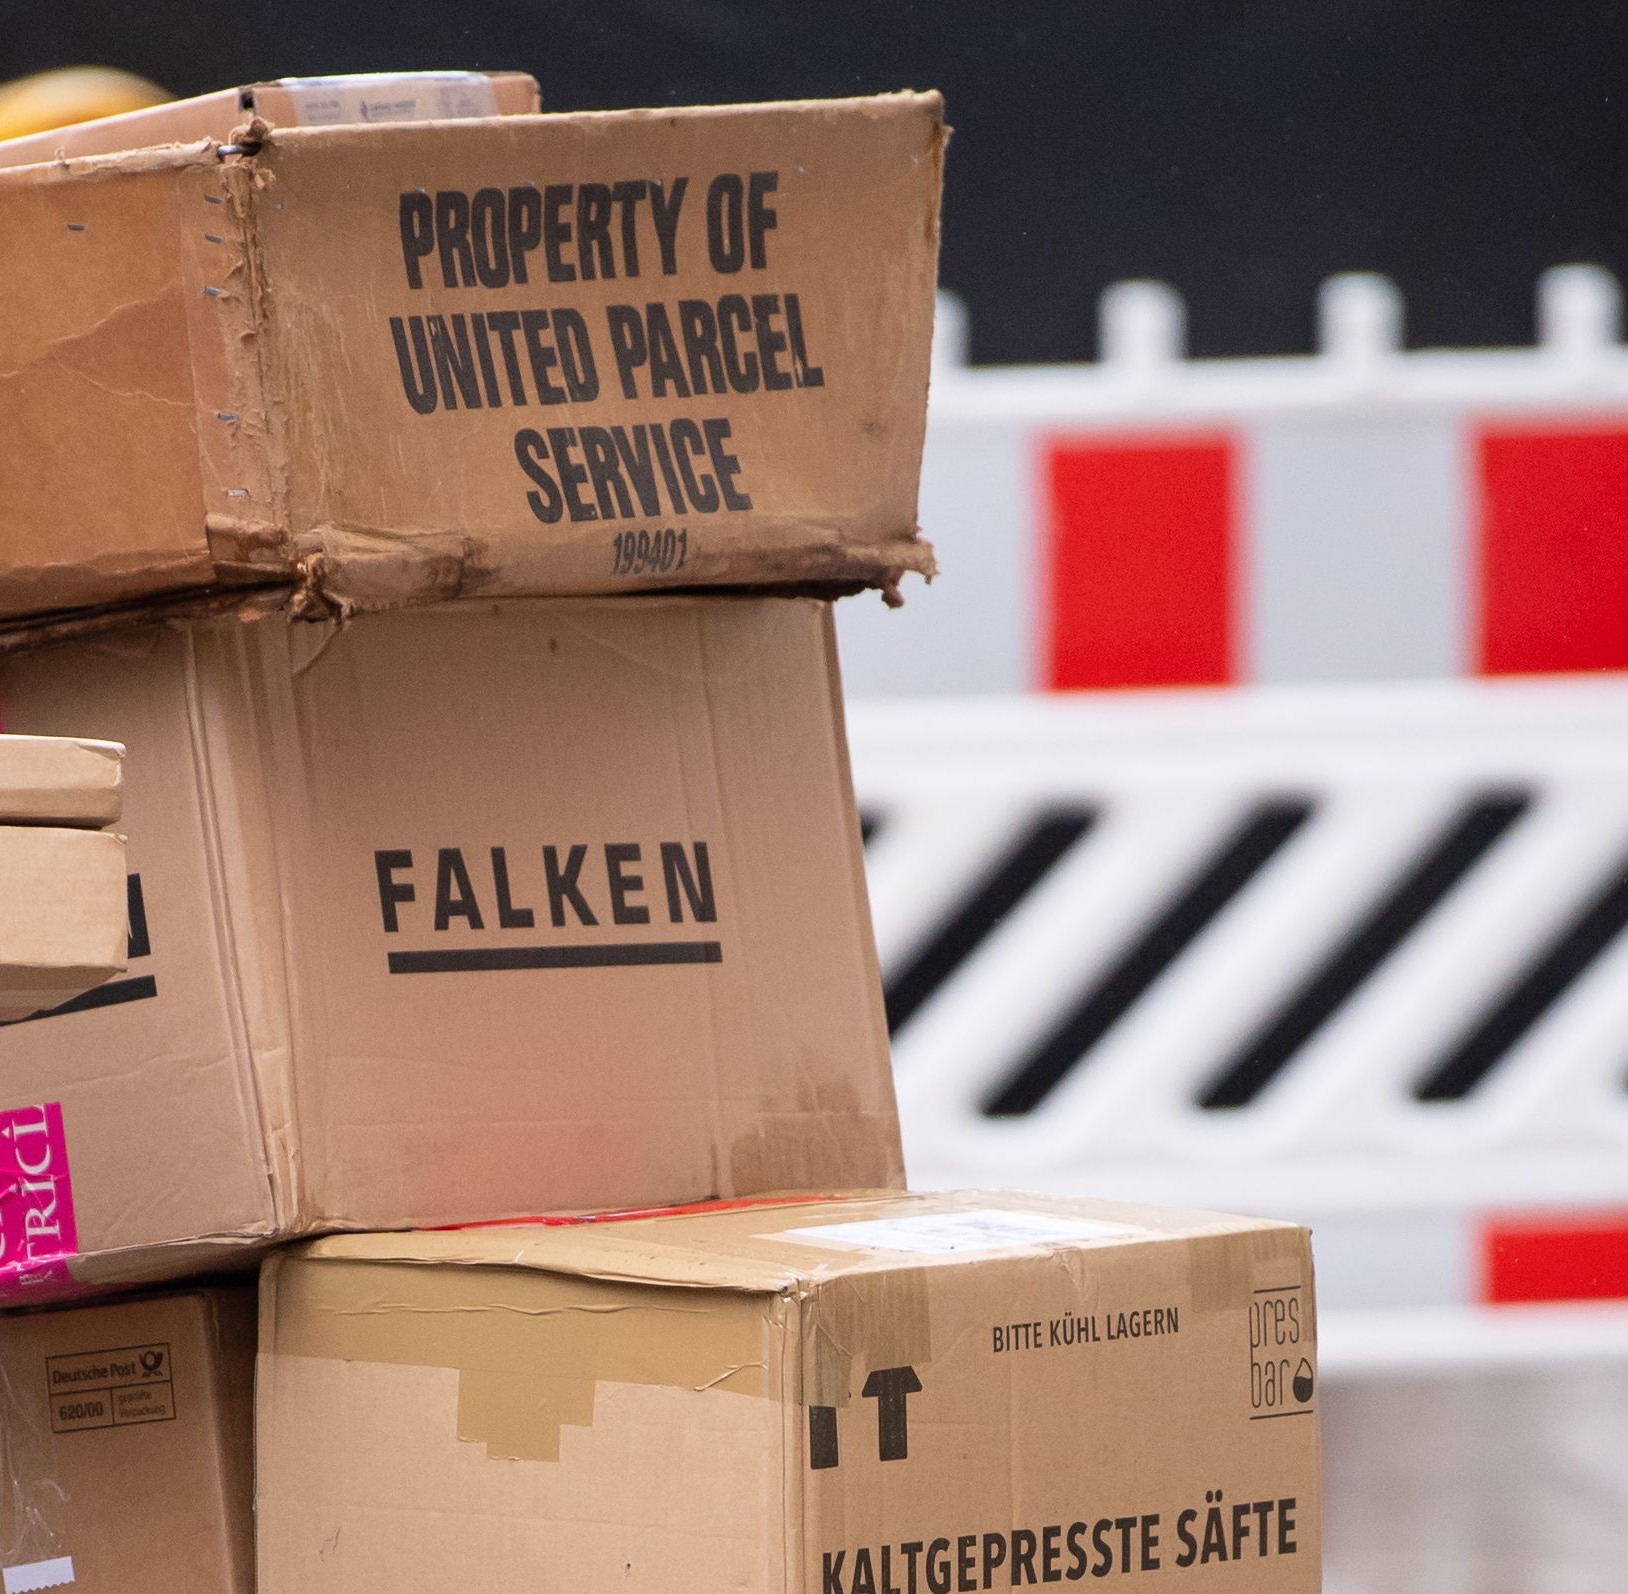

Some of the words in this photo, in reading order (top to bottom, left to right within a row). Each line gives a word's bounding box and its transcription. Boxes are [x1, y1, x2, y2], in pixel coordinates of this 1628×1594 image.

[399, 177, 690, 289] PROPERTY
[707, 171, 779, 274] OF
[389, 308, 600, 414] UNITED
[607, 293, 825, 400] PARCEL
[515, 417, 753, 523] SERVICE
[612, 528, 688, 574] 199401
[374, 841, 717, 933] FALKEN
[993, 1321, 1043, 1352] BITTE
[1049, 1311, 1101, 1347] KÜHL
[1107, 1307, 1180, 1340] LAGERN
[53, 1366, 107, 1385] Deutsche
[108, 1362, 137, 1379] Post
[1176, 1490, 1297, 1567] SÄFTE
